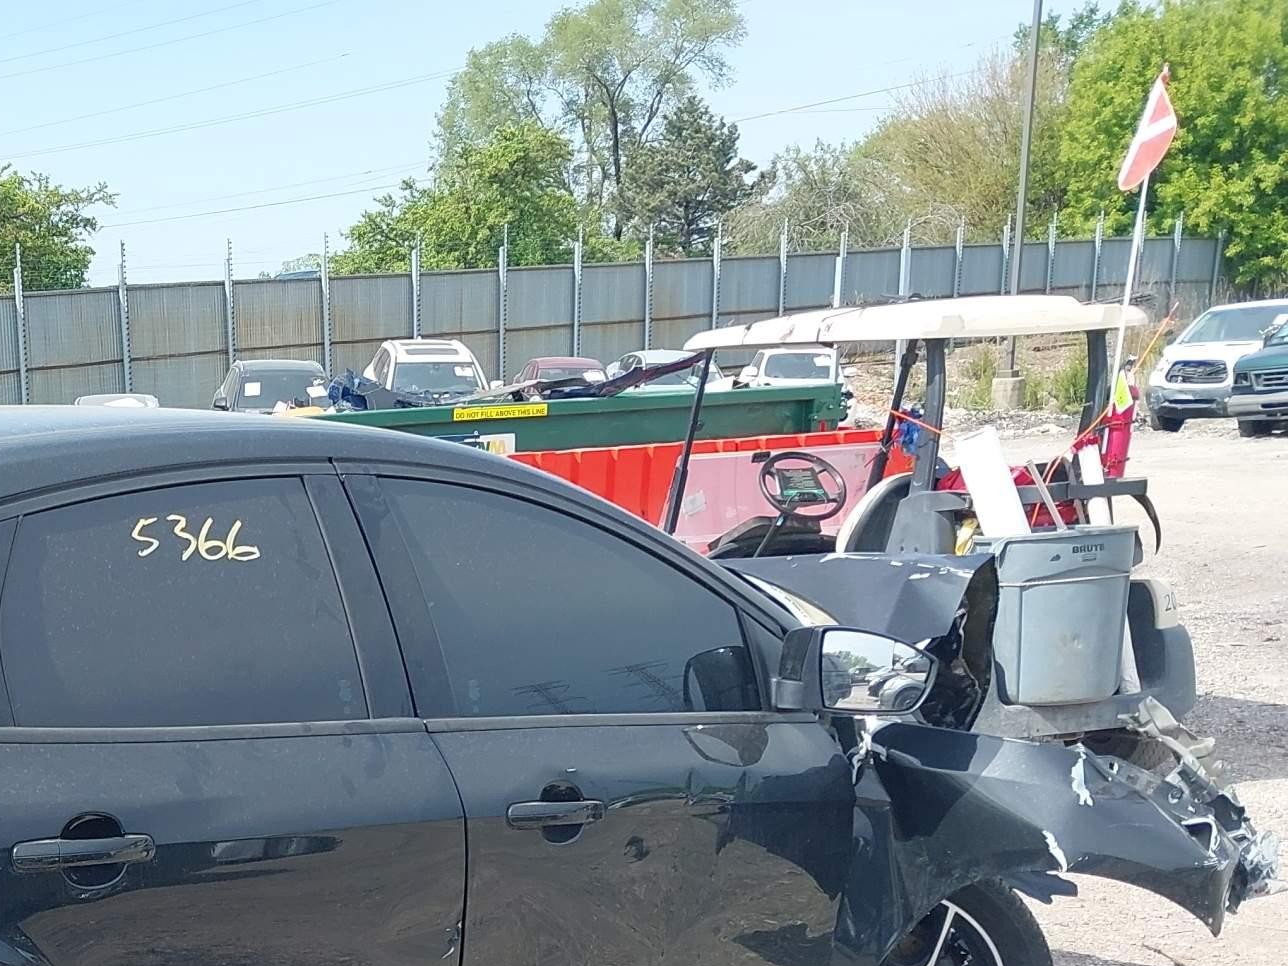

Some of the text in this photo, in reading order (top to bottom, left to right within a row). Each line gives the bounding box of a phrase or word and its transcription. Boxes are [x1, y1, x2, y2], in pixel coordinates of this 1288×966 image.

[466, 411, 479, 419] NOT
[480, 410, 493, 418] FILL
[495, 409, 515, 417] ABOVE
[516, 408, 530, 416] THIS
[531, 407, 545, 415] LINE
[131, 514, 261, 561] 5366
[1072, 543, 1104, 553] BRUTE
